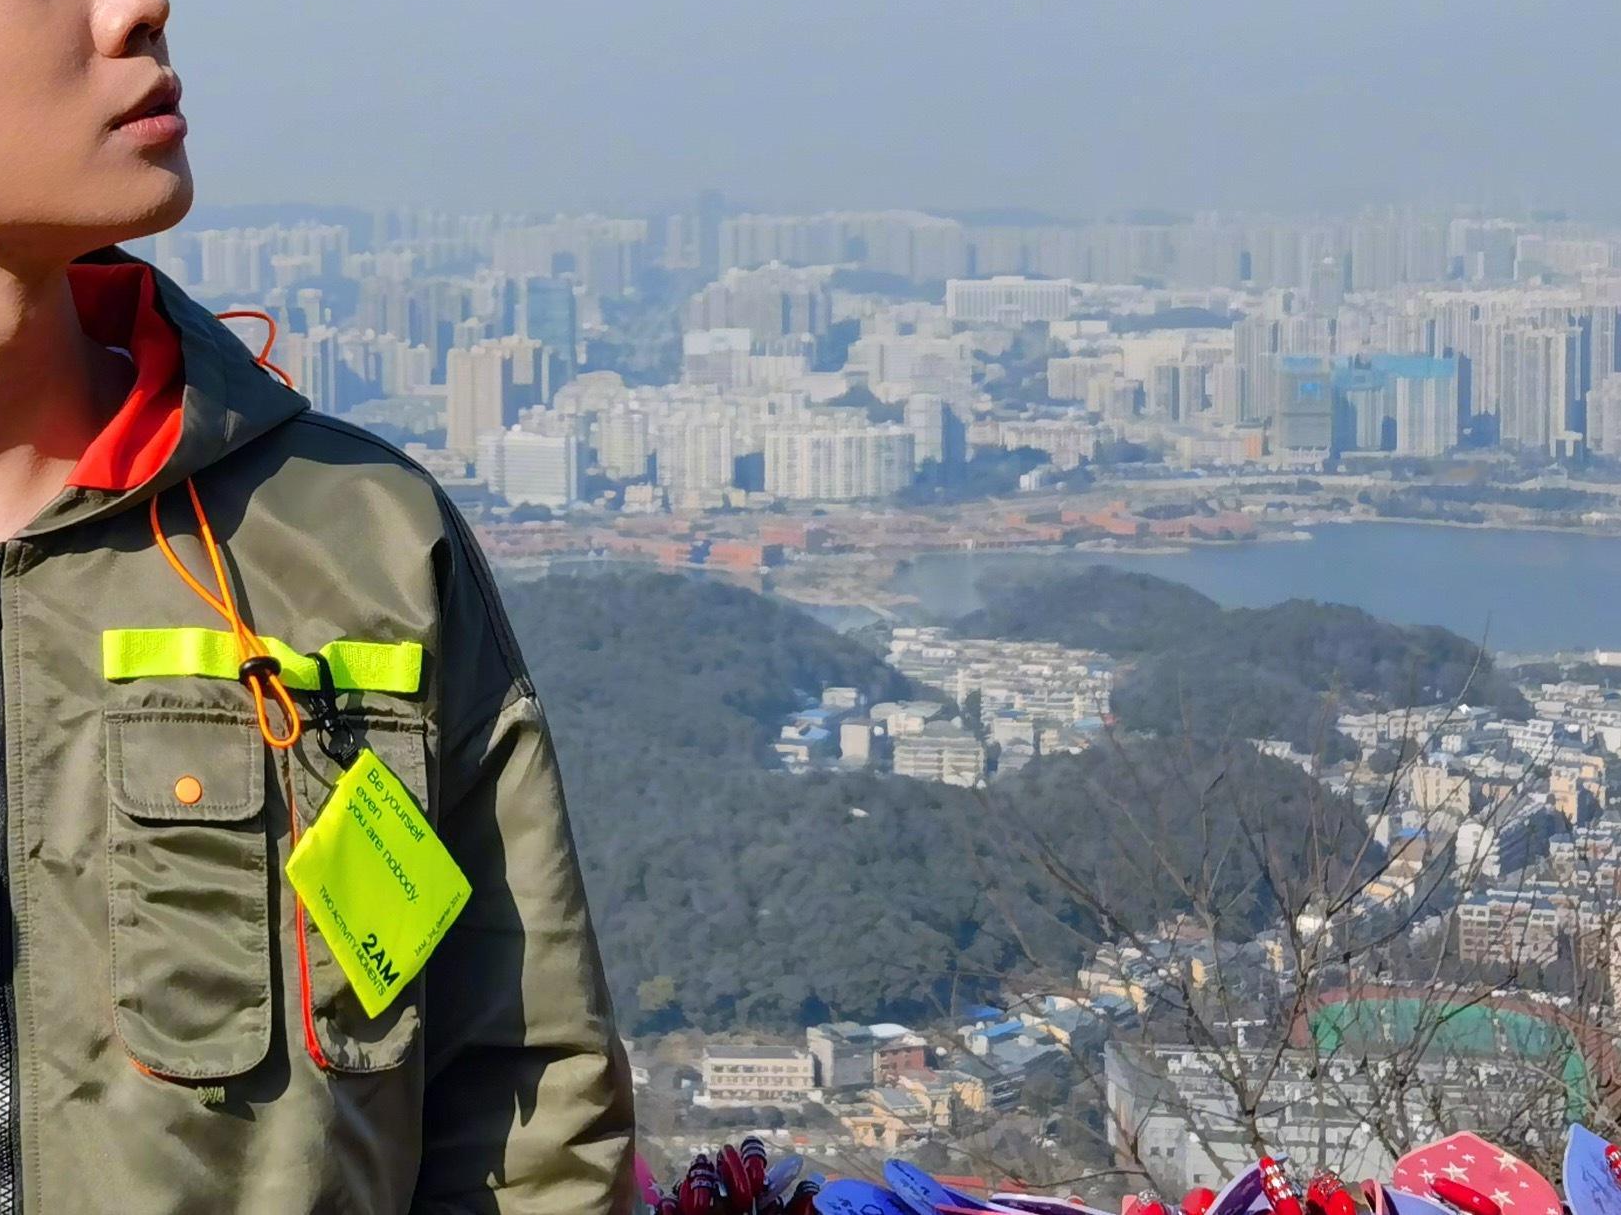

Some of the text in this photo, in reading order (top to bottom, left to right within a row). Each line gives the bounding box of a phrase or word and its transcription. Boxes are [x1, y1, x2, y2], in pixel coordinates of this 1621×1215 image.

[346, 798, 367, 827] you
[366, 826, 384, 851] are
[356, 786, 382, 820] even
[367, 768, 426, 842] Be yourself
[320, 885, 386, 996] TWO ACTIVITY MOMENTS
[361, 933, 400, 987] 2AM
